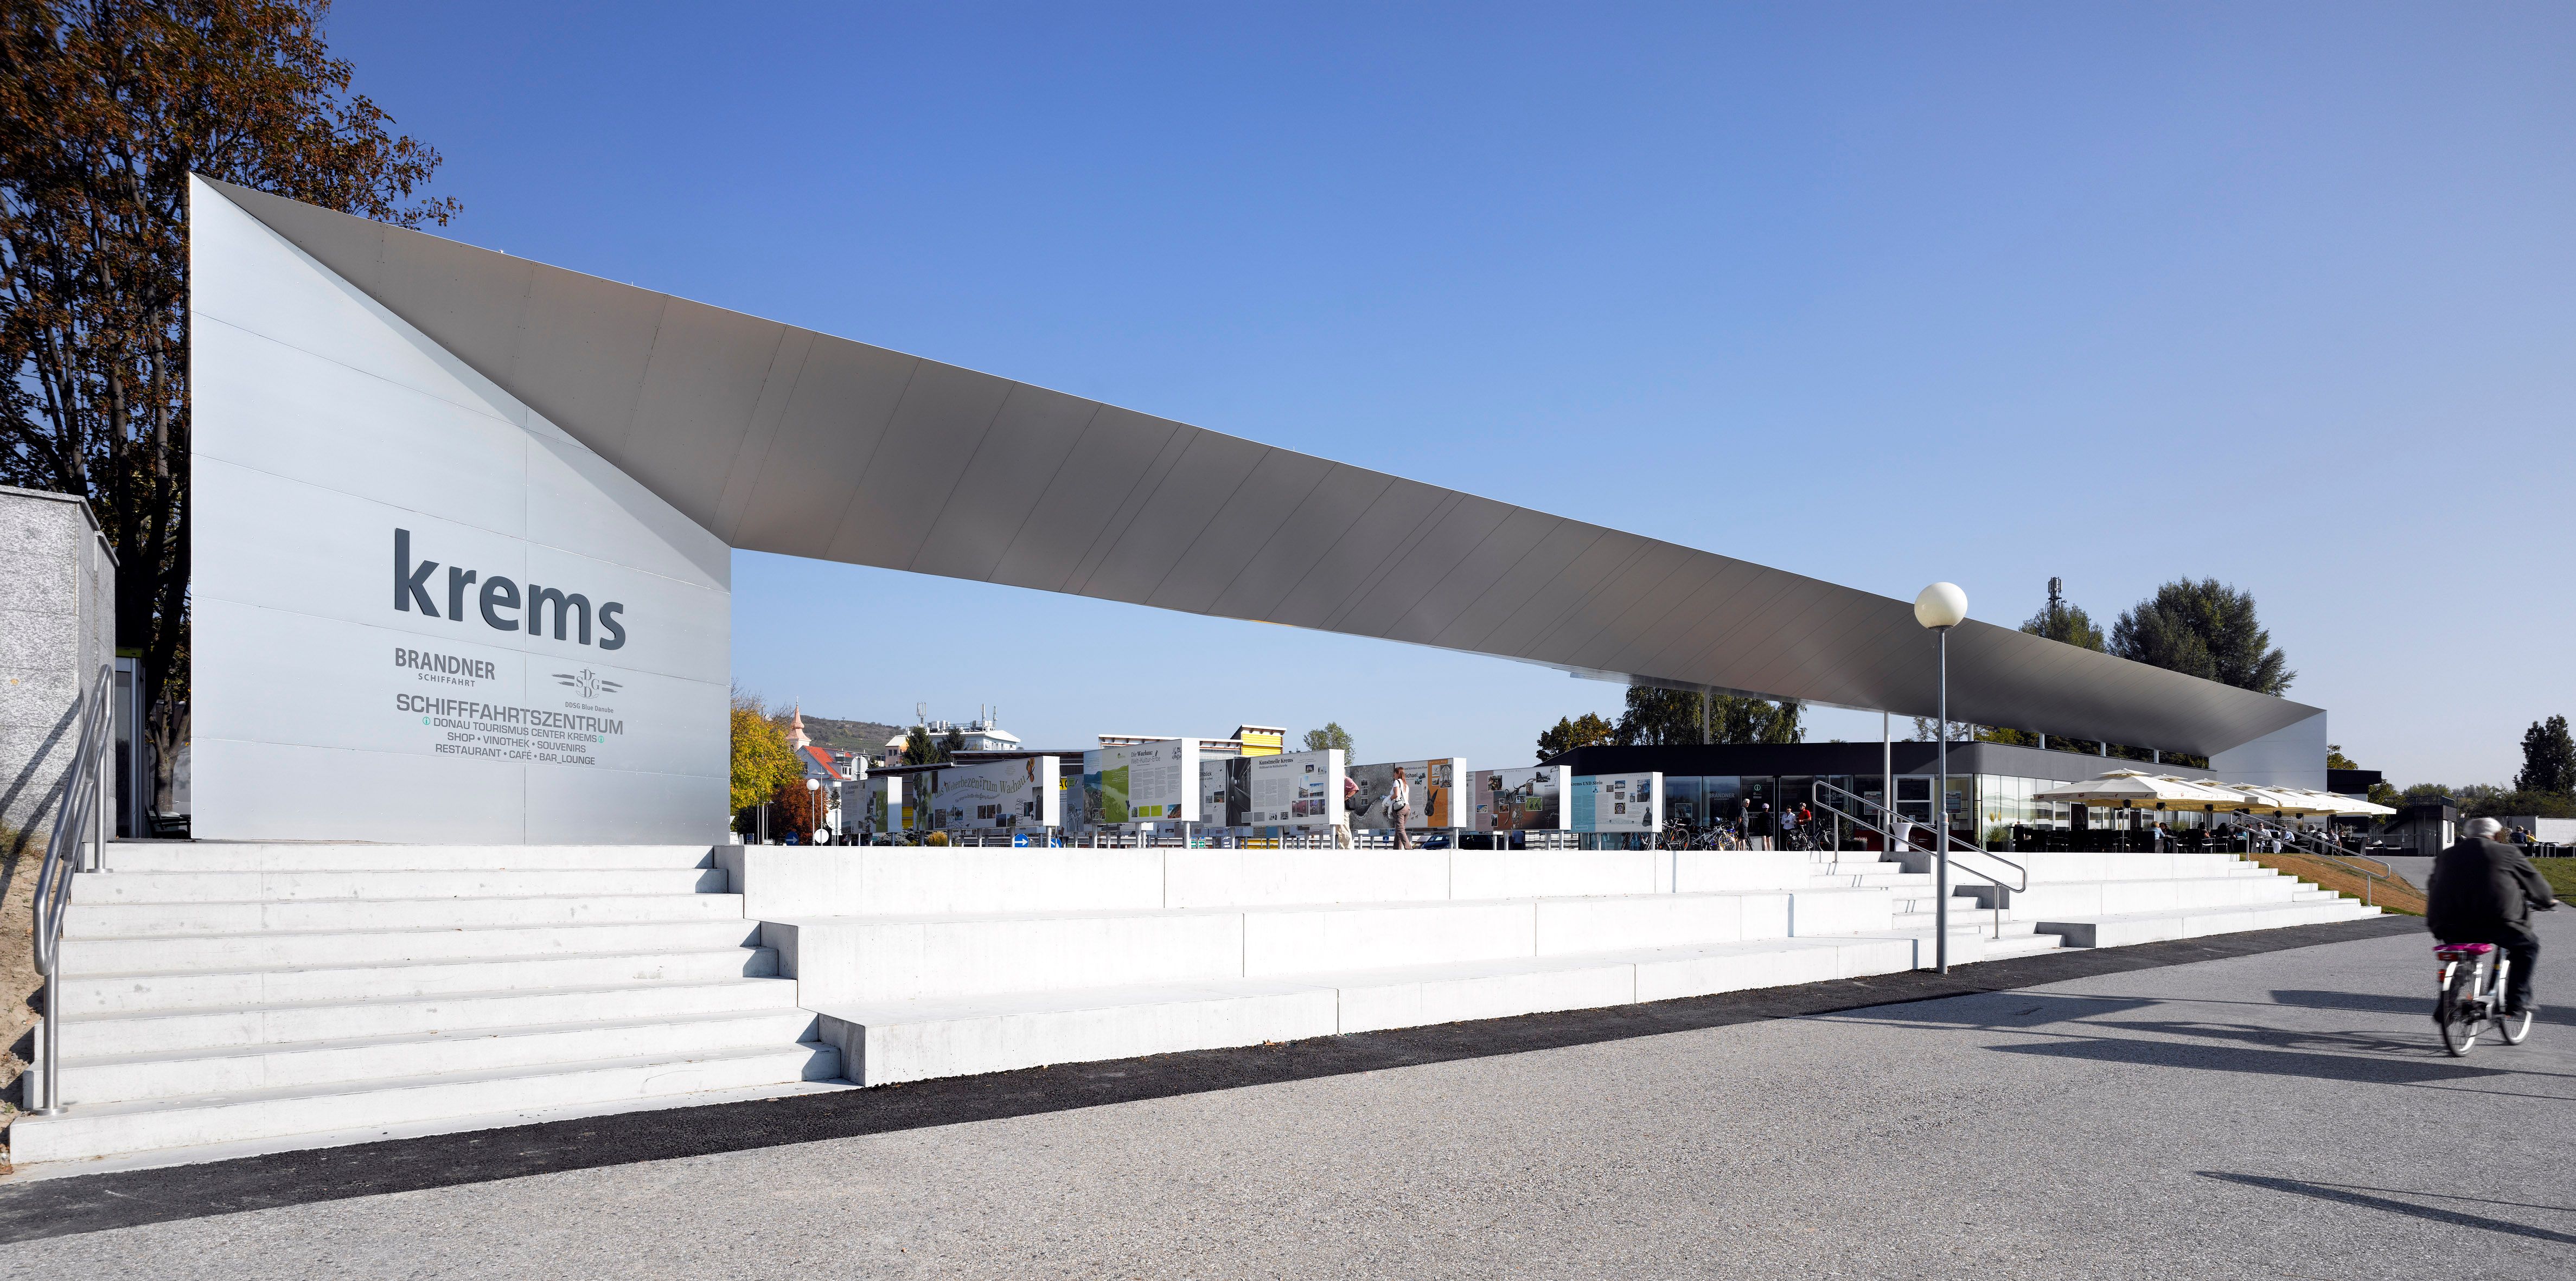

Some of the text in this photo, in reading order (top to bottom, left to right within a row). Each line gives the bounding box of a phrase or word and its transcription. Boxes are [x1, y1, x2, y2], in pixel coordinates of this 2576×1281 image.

[394, 528, 626, 650] krems
[395, 648, 495, 680] BRANDNER
[418, 673, 475, 687] SCHIFFAHRT
[397, 693, 623, 735] SCHIFFFAHRTSZENTRUM
[595, 705, 614, 713] Danube
[433, 718, 597, 742] DONAU TOURISMUS CENTER KREMS
[448, 732, 586, 753] SHOP VINOTHEK SOUVENIRS
[436, 744, 596, 765] RESTAURANT CAFÉ BAR_LOUNGE
[999, 776, 1026, 794] Wachau
